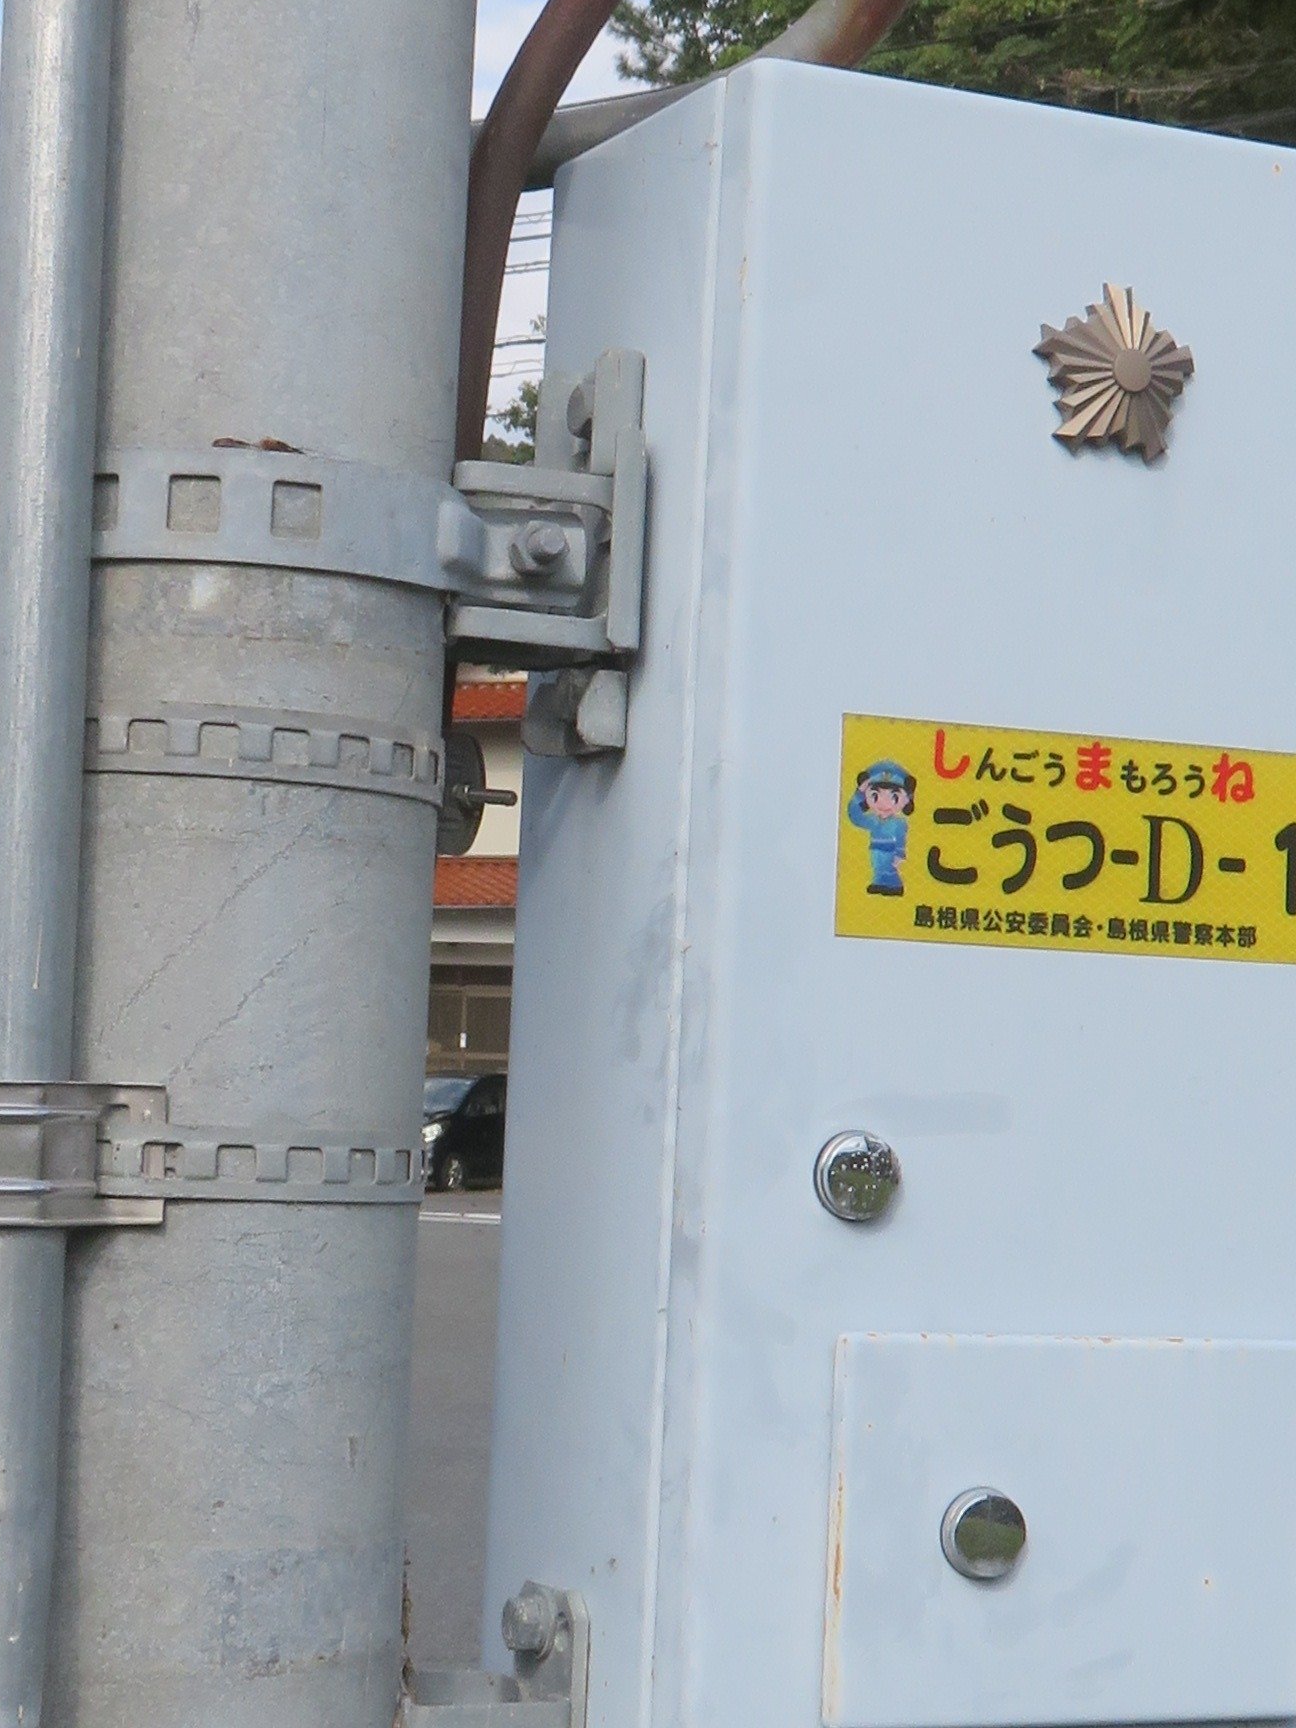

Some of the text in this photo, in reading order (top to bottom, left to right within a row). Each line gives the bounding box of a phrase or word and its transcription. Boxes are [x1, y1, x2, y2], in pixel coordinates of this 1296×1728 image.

[933, 729, 1256, 804] しんごうまもろうね
